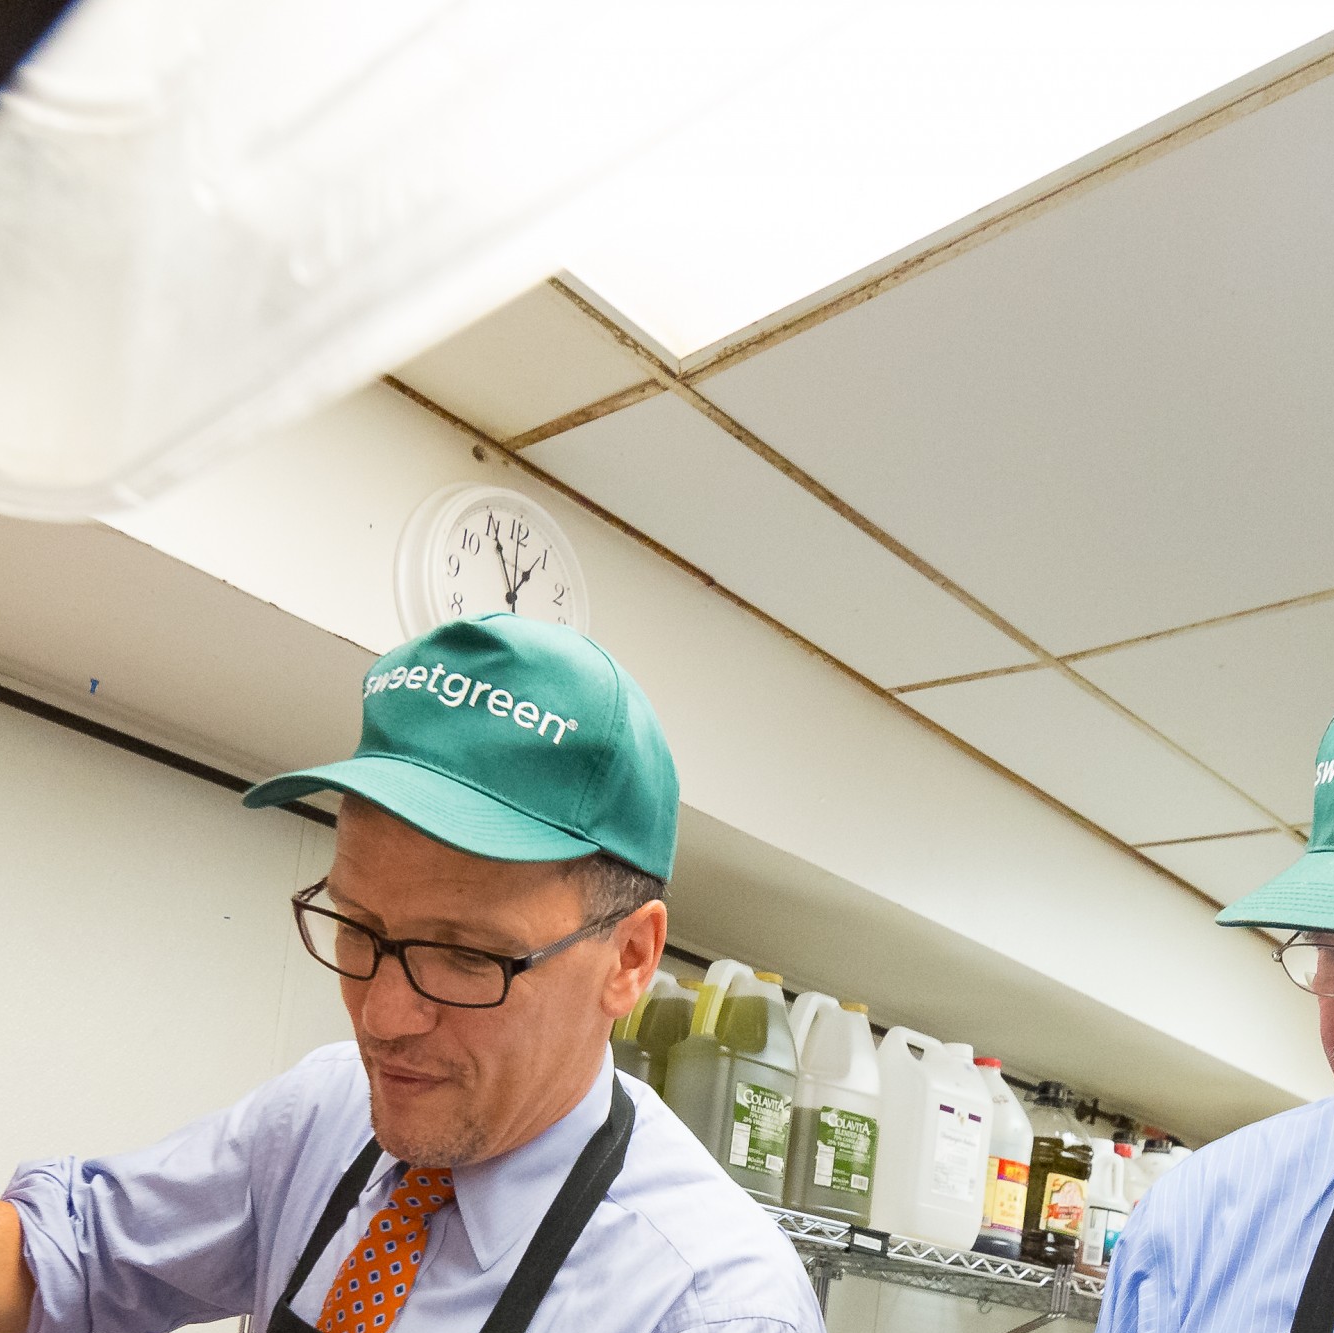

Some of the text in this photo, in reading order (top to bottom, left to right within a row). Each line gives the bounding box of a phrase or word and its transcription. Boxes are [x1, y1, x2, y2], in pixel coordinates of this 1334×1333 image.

[461, 528, 480, 556] 10
[510, 518, 530, 548] 12
[447, 554, 460, 578] 9
[451, 592, 464, 616] 8
[552, 582, 565, 607] 2
[743, 1089, 785, 1113] COLAVITA
[828, 1113, 871, 1136] COLAVITA
